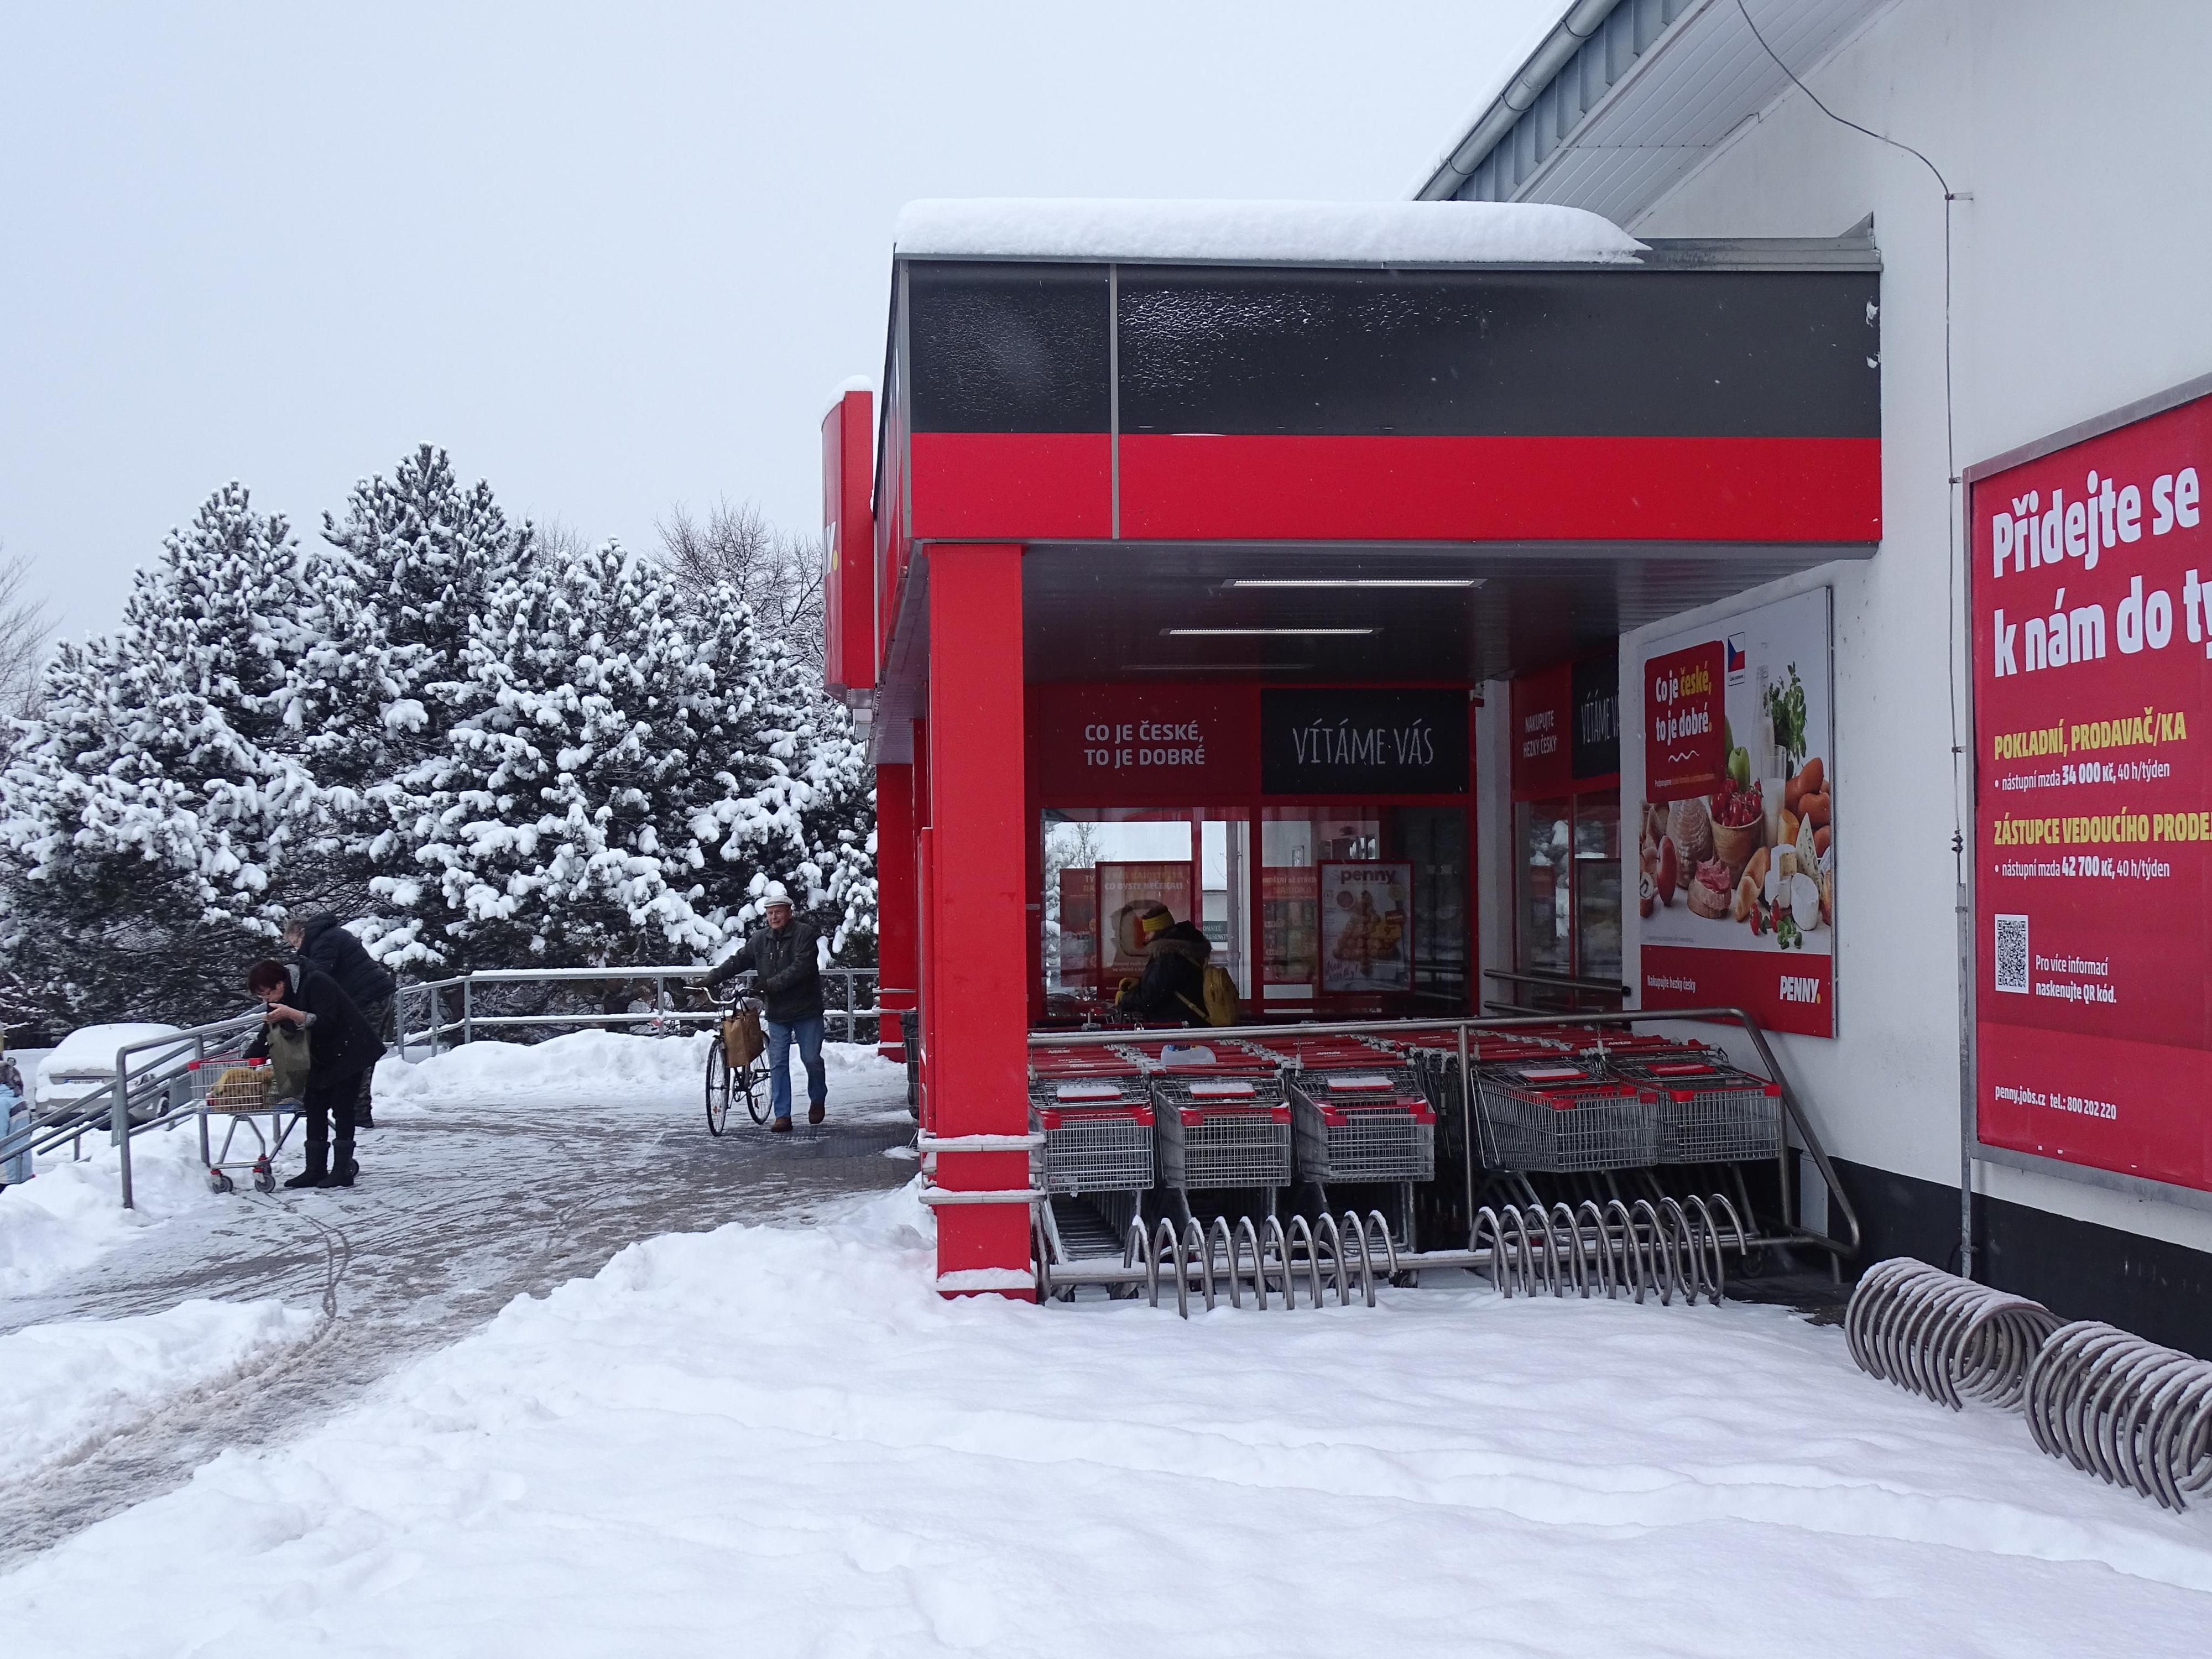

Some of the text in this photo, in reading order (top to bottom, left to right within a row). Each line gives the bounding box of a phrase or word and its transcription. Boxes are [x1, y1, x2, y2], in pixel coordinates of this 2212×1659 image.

[1992, 467, 2200, 578] Přidejte se
[1994, 608, 2017, 677] k
[2025, 587, 2106, 672] nám
[2116, 575, 2173, 654] do
[1655, 660, 1712, 706] Co je české,
[1084, 720, 1204, 744] CO JE ČESKÉ,
[1525, 709, 1554, 731] NAKUPUJTE
[1580, 688, 1610, 745] VÍTÁME
[1656, 702, 1712, 746] to je dobré.
[1994, 706, 2187, 760] POKLADNÍ, PRODAVAČ/KA
[1084, 745, 1205, 769] TO JE DOBRÉ
[1292, 718, 1434, 765] VÍTÁME VÁS
[1522, 738, 1539, 758] HEZKY
[2002, 759, 2170, 792] nástupní mzda 34 000 Kč, 40 h/týden
[1994, 806, 2212, 845] ZÁSTUPCE VEDOUCÍHO PRODE
[1340, 869, 1396, 885] penny
[2002, 855, 2170, 880] nástupní mzda 42 700 Kč, 40 h/týden
[2036, 953, 2109, 976] Pro více informací
[1779, 975, 1821, 1005] PENNY.
[2036, 981, 2117, 1005] naskenujte QR kód.
[1995, 1084, 2116, 1120] penny.jobs.cz tel.: 800 202 220
